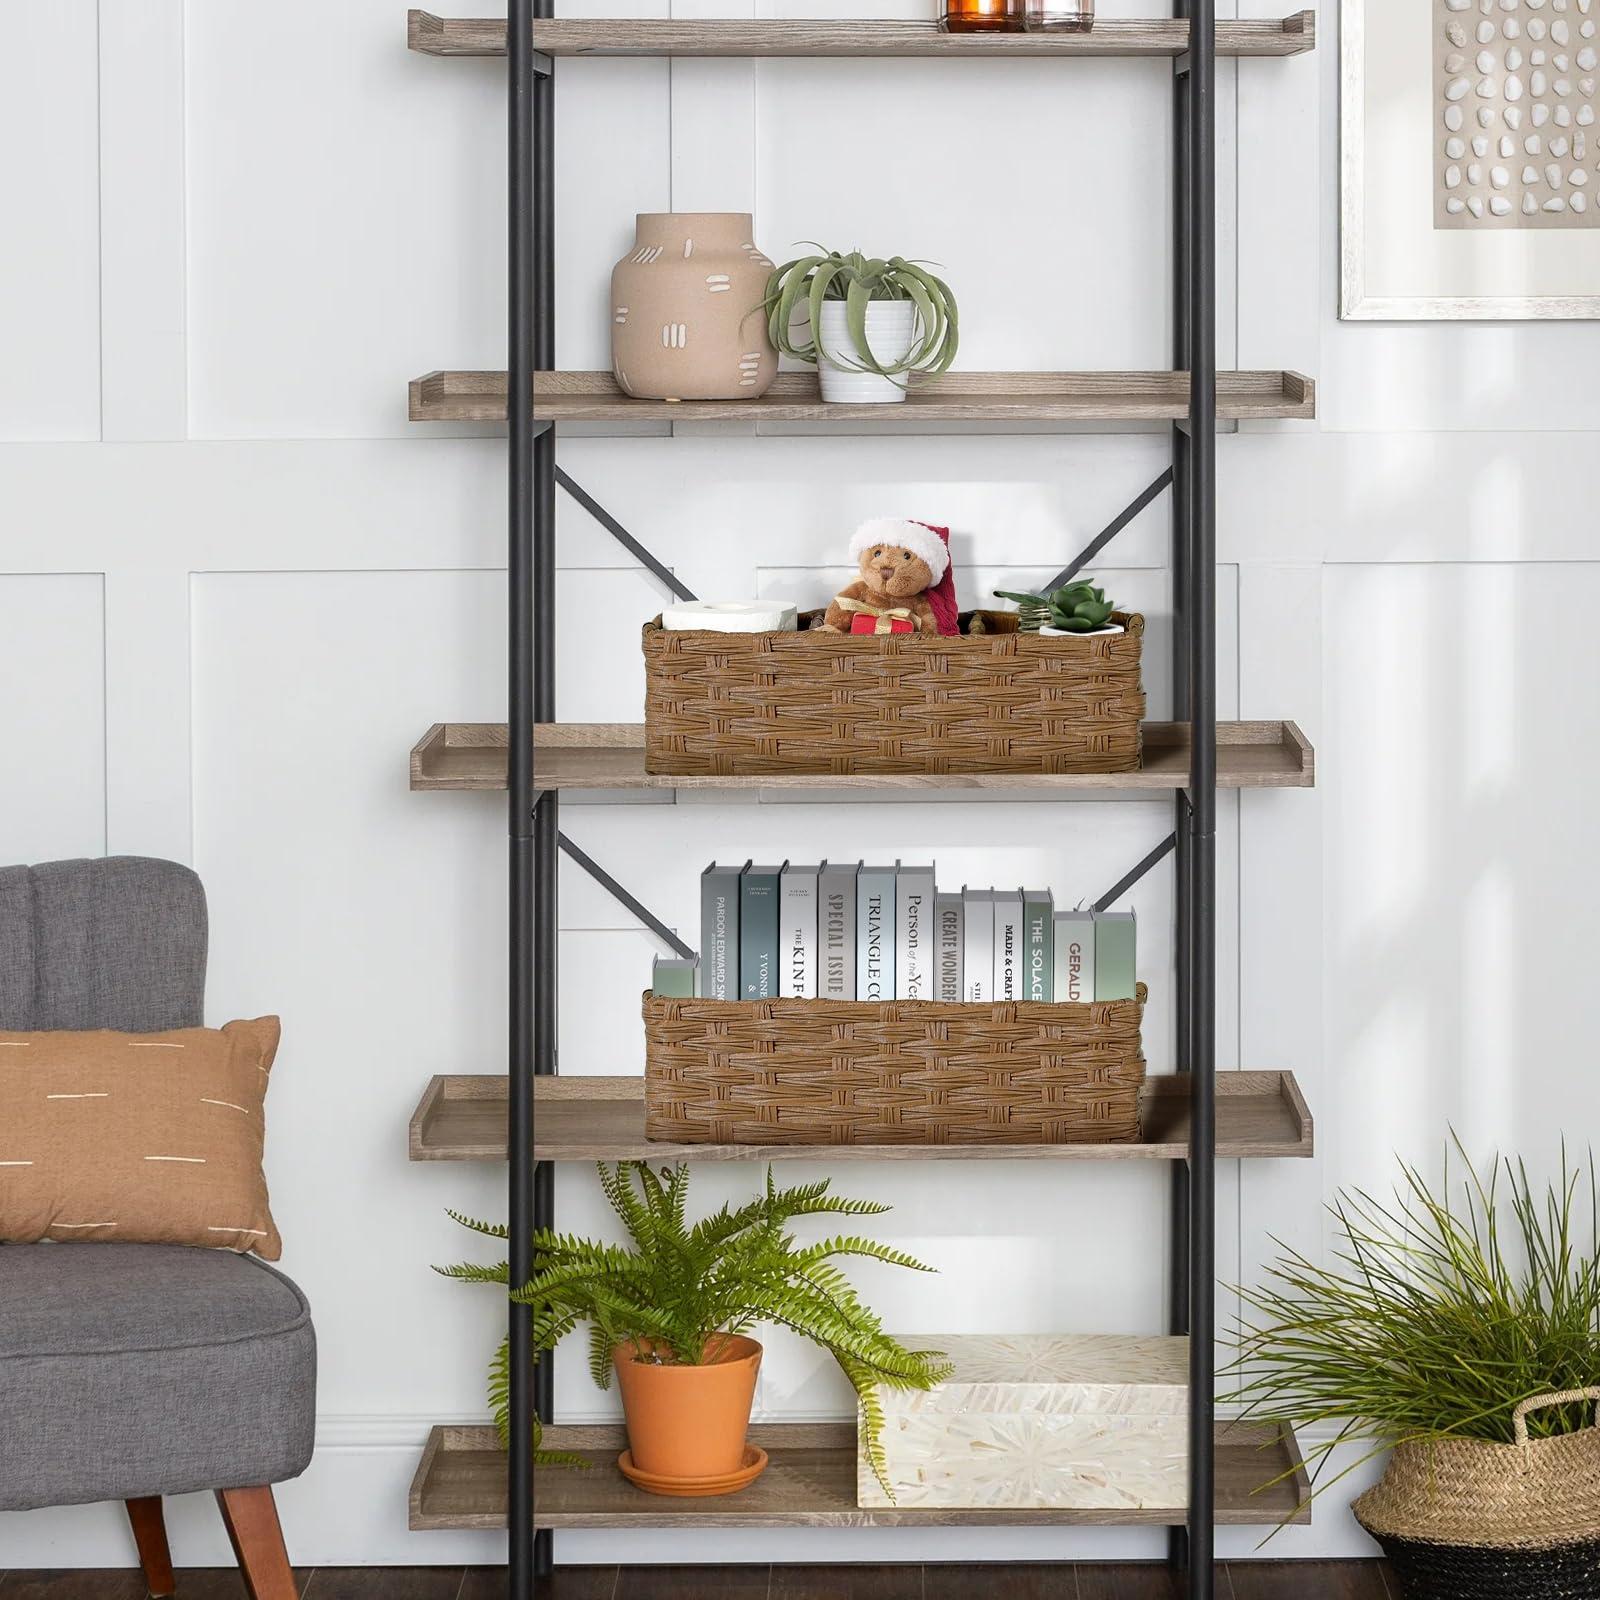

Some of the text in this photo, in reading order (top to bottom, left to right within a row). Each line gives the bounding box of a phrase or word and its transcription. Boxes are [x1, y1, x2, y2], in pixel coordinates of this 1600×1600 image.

[716, 896, 725, 938] PARDON
[868, 895, 881, 979] TRIANGLE
[908, 895, 922, 949] Person
[942, 911, 957, 947] CREATE
[716, 940, 725, 982] EDWARD
[828, 894, 844, 992] SPECIAL ISSUE
[908, 950, 917, 960] of
[1005, 925, 1013, 956] MADE
[1032, 917, 1042, 1000] THE SOLACE
[908, 962, 916, 976] the
[1005, 958, 1013, 966] &
[1068, 942, 1080, 1000] GERALD
